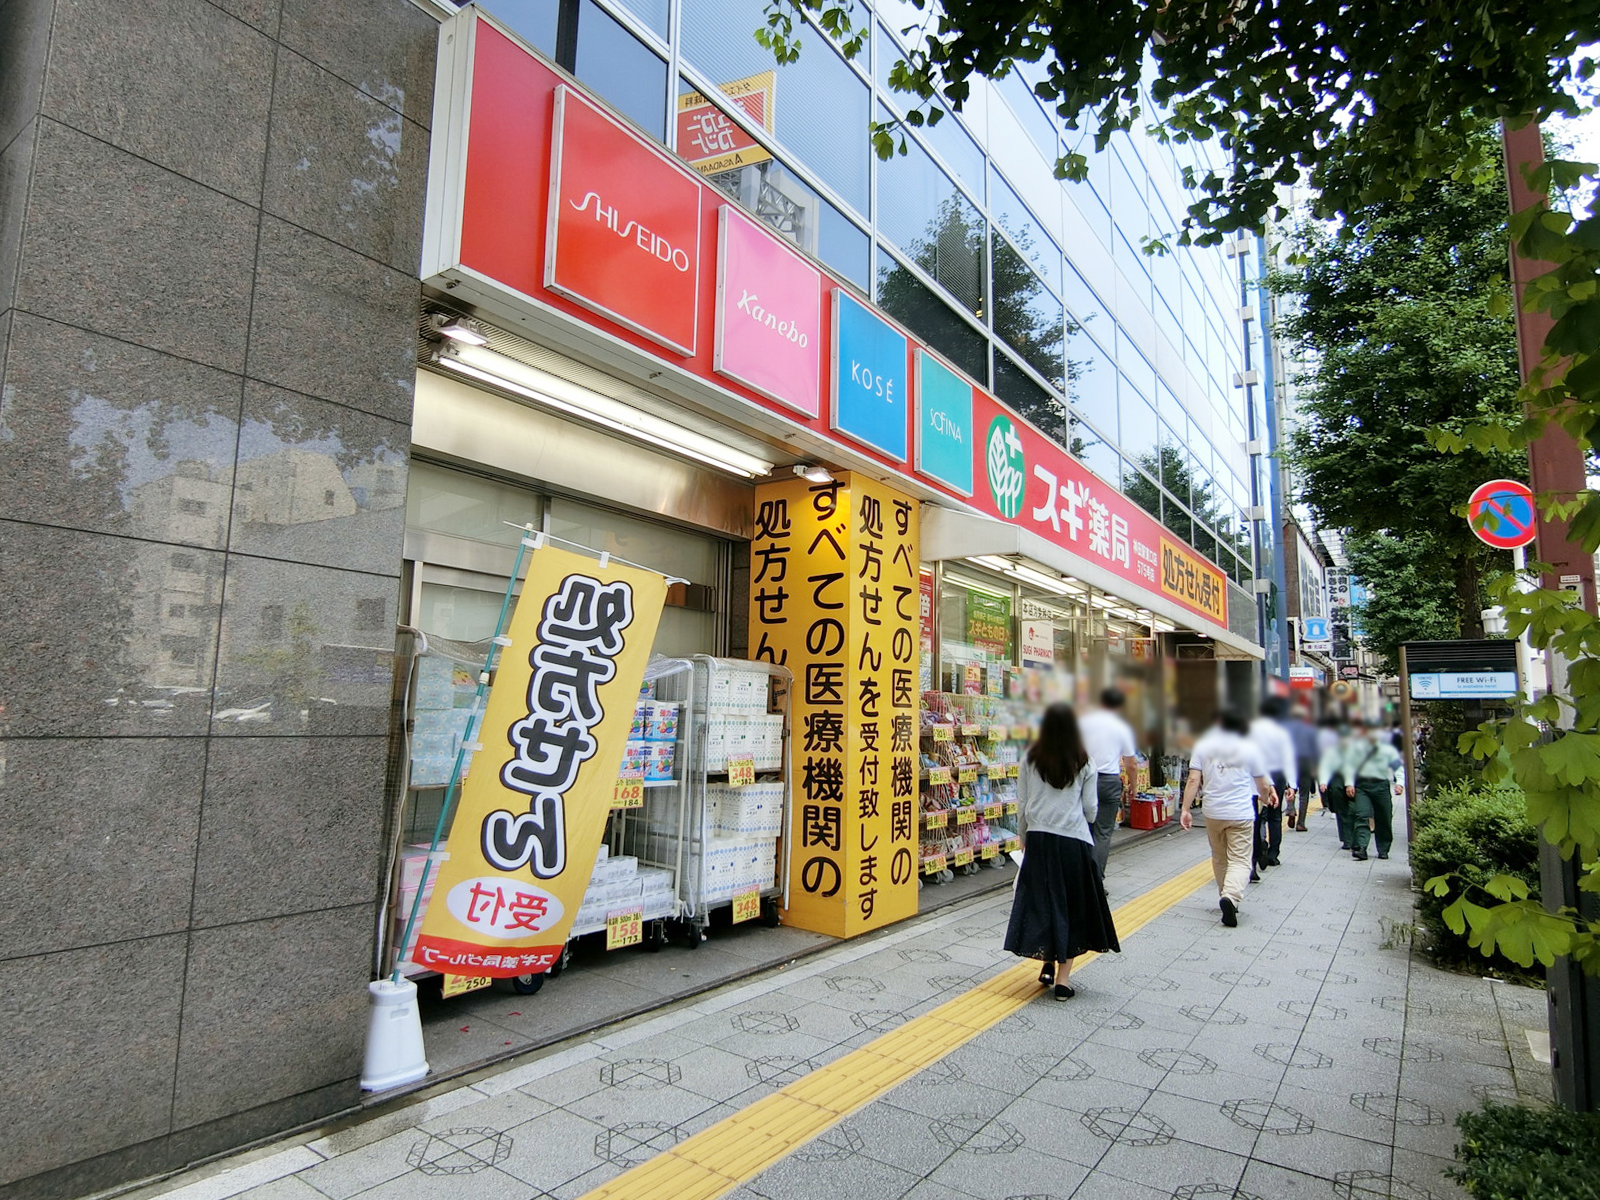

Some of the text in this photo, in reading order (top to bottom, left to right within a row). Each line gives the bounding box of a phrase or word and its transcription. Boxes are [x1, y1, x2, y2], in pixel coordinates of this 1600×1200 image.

[569, 192, 690, 273] SHISEIDO
[737, 289, 808, 349] Kanebo
[851, 358, 894, 404] KOSÉ
[930, 407, 962, 444] SOFINA
[1032, 464, 1130, 570] スギ薬局
[1163, 544, 1220, 615] 処方せん受付
[753, 499, 790, 712] 処方せん
[801, 480, 846, 897] すべての医療機関の
[858, 494, 883, 921] 処方せんを受付致します
[890, 499, 913, 885] すべての医療機関の
[613, 785, 640, 801] 168
[732, 767, 752, 780] 348
[623, 799, 639, 807] 184
[736, 899, 757, 915] 348
[612, 921, 639, 940] 158
[622, 935, 638, 945] 173
[466, 976, 486, 990] 250
